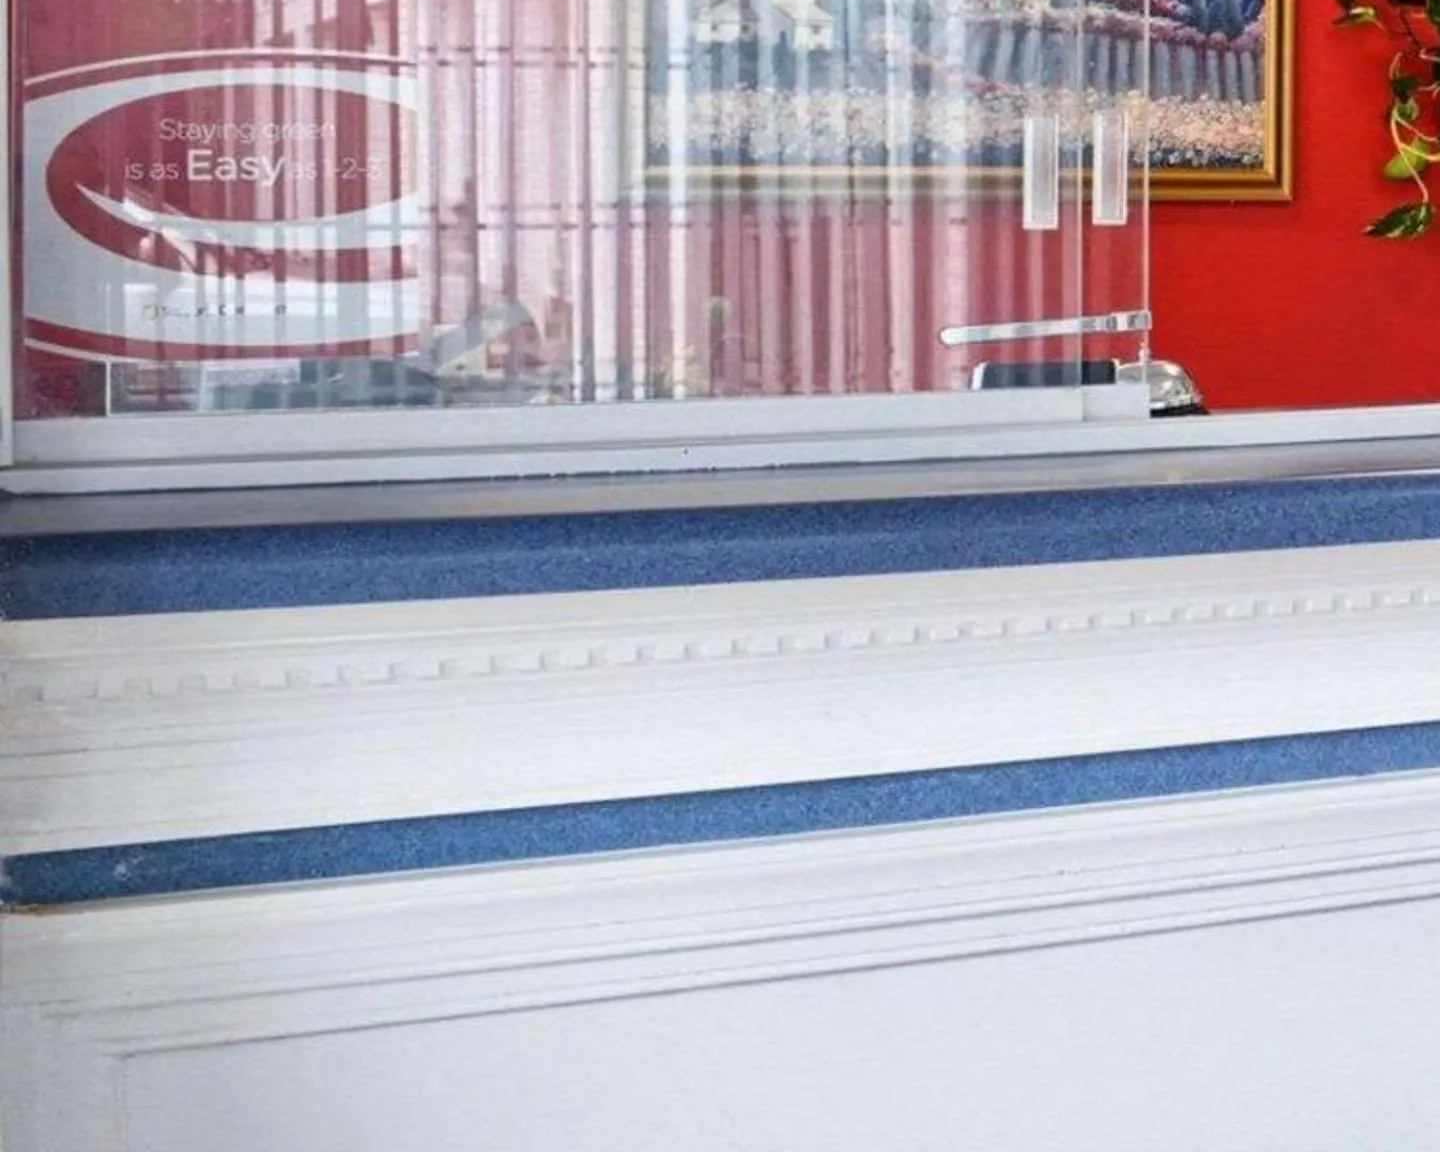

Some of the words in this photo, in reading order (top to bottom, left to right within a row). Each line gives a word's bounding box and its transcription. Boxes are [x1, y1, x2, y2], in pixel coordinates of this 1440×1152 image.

[159, 117, 255, 144] Staying
[124, 157, 144, 180] is
[150, 162, 179, 180] as
[186, 148, 284, 188] Easy
[288, 161, 317, 180] as
